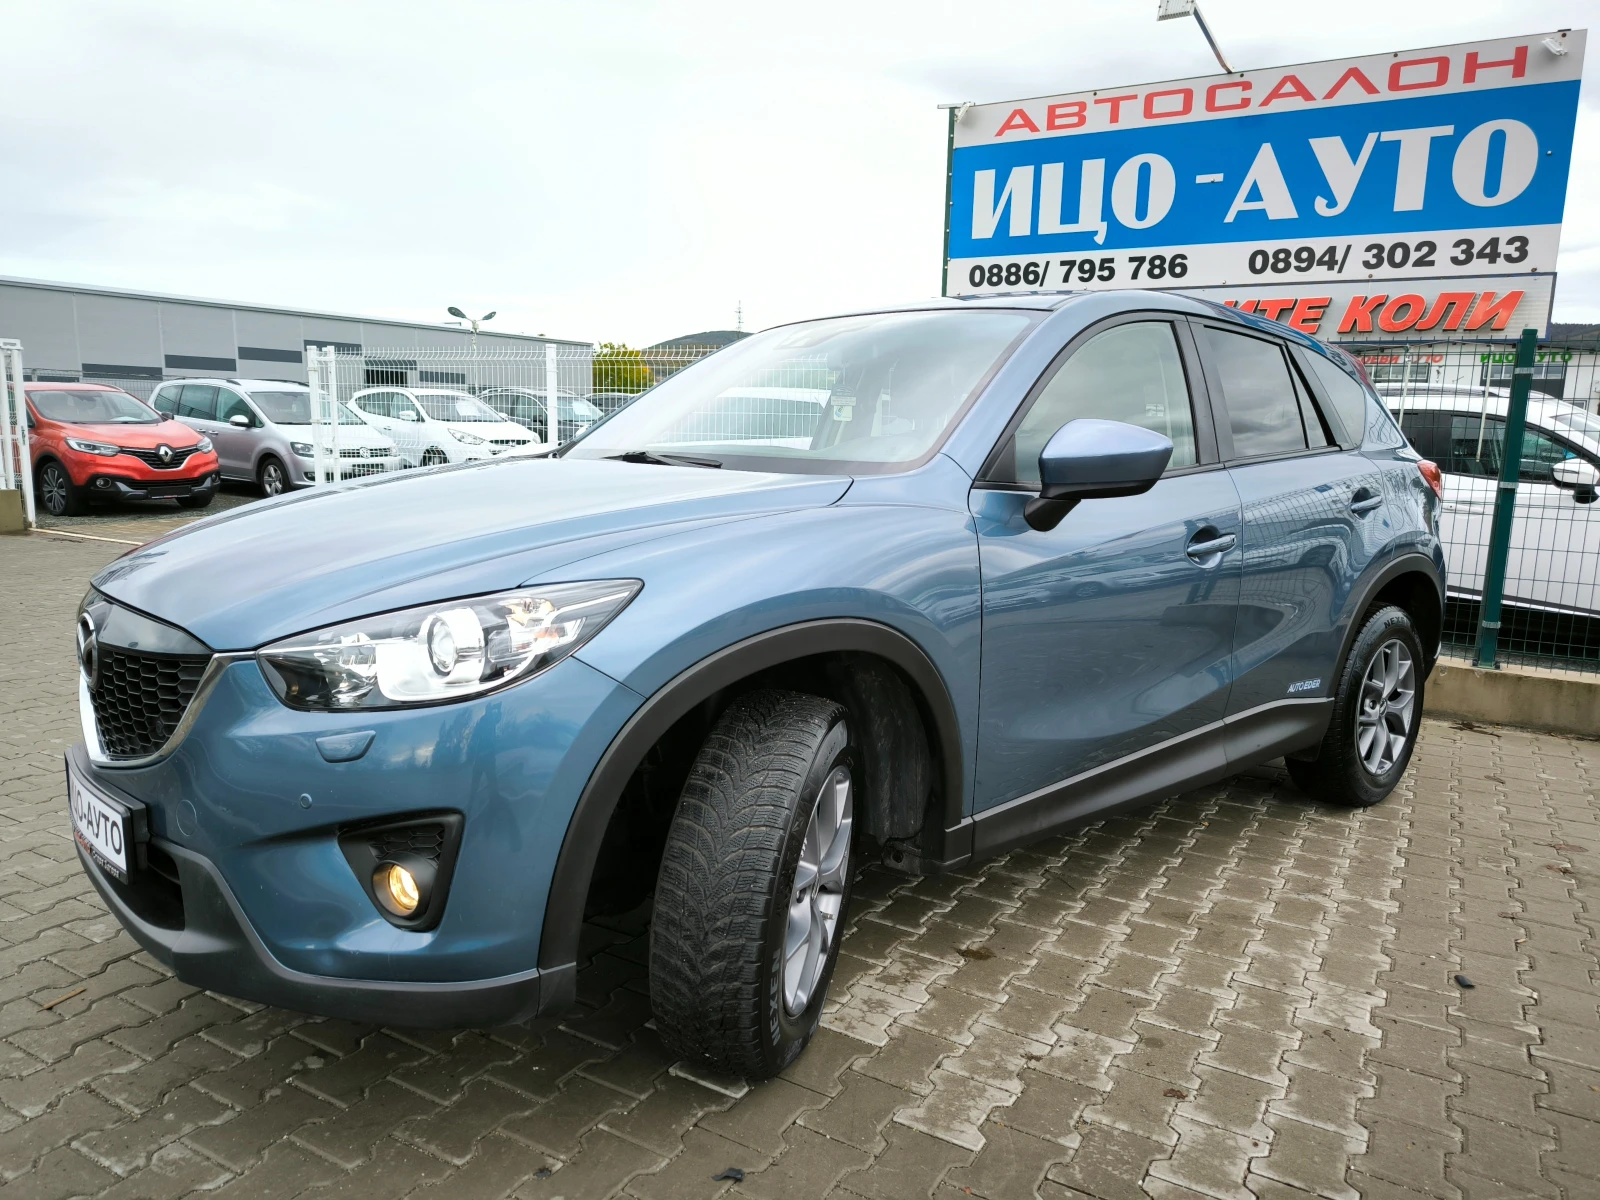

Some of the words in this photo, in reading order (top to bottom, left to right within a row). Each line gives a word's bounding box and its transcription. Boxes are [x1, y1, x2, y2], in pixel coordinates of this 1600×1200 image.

[994, 46, 1528, 137] АВТОСАЛОН
[971, 153, 1176, 246] ИЦО
[968, 261, 1050, 287] 0886/
[1059, 257, 1116, 283] 795
[1128, 254, 1188, 280] 786
[1248, 244, 1352, 274] 0894/
[1362, 240, 1437, 270] 302
[1450, 236, 1530, 266] 343
[1337, 290, 1526, 333] КОЛИ
[769, 948, 781, 1046] NEXEN
